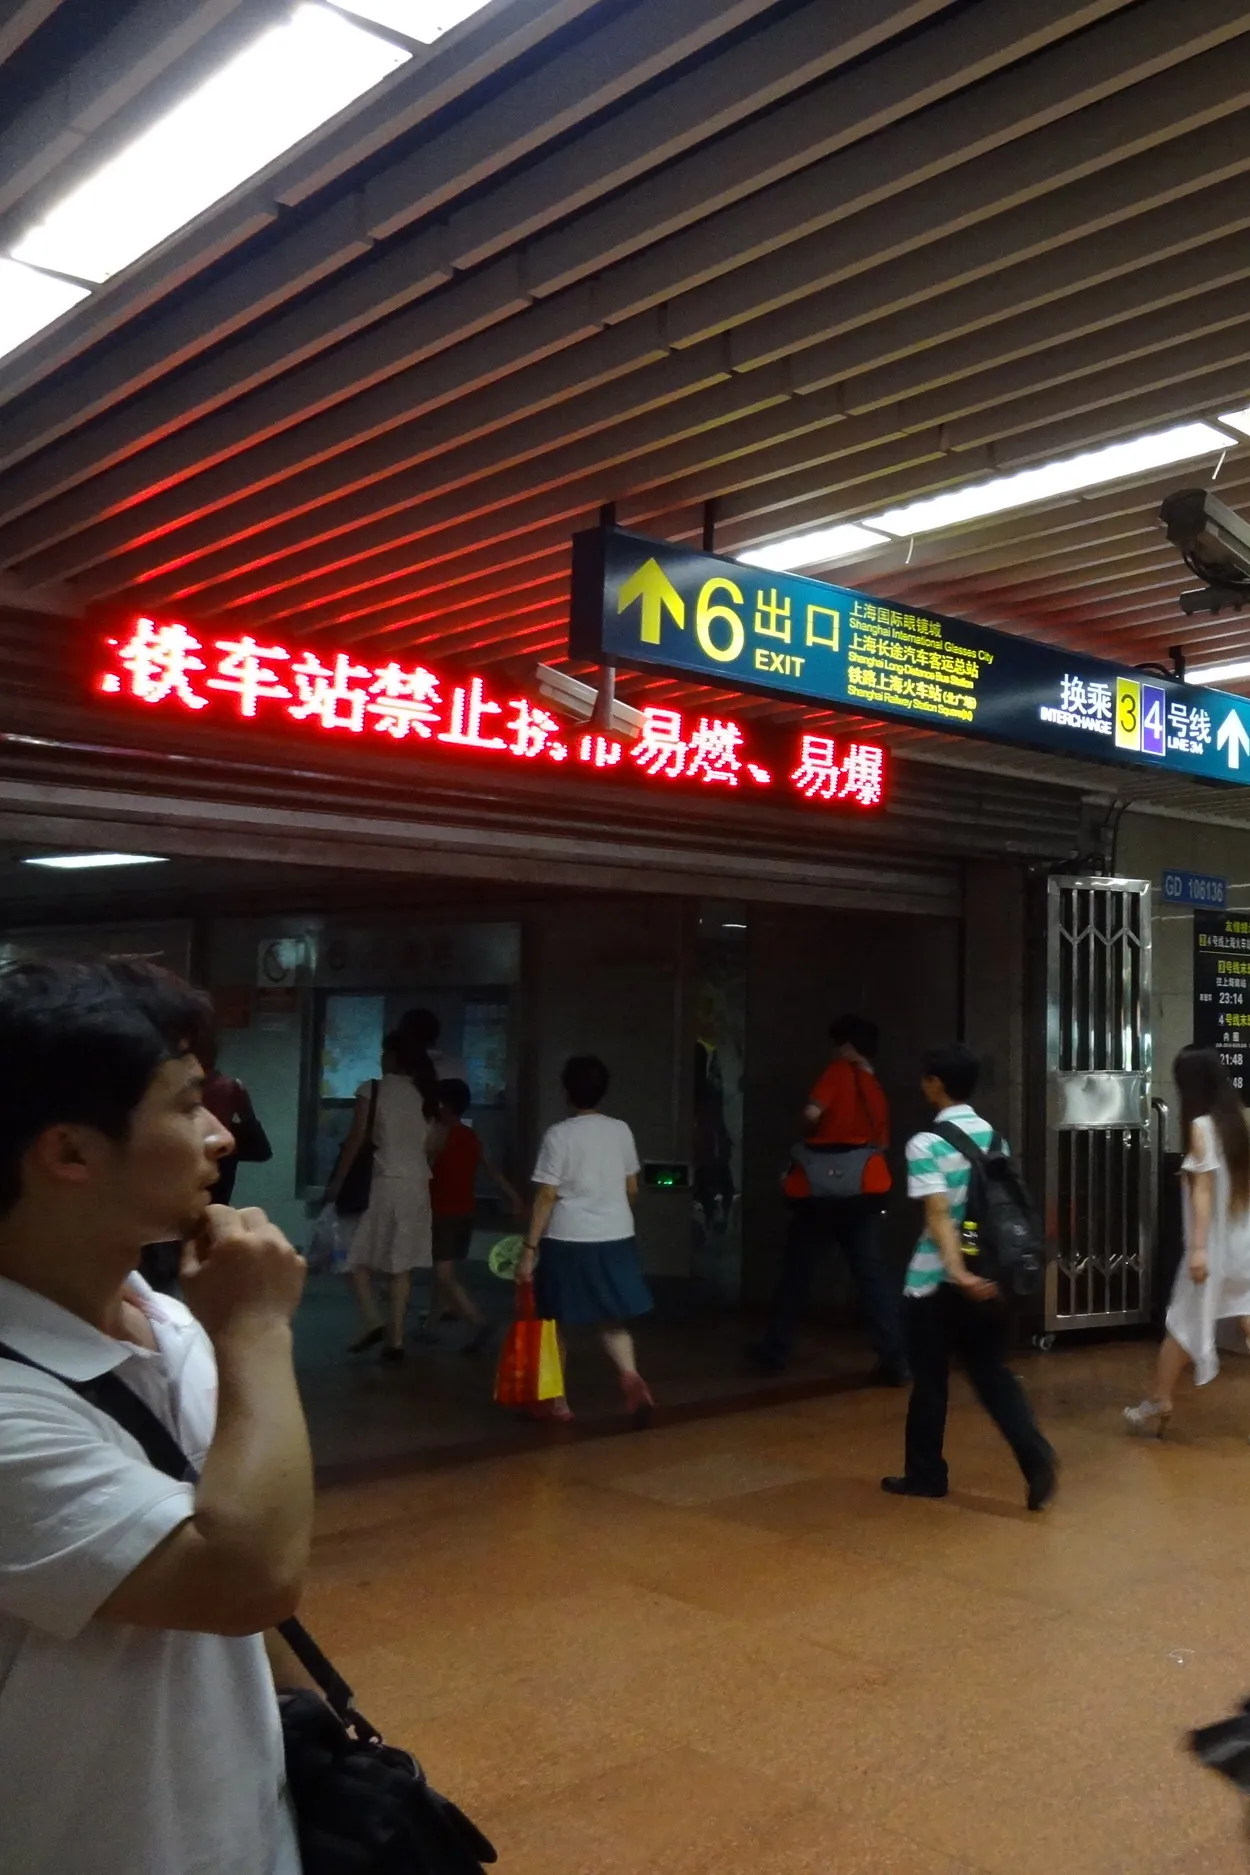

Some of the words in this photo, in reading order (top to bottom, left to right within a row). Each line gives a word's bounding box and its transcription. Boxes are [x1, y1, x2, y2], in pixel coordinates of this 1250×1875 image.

[695, 577, 745, 663] 6
[754, 588, 840, 652] 出口
[849, 600, 942, 638] 上海国际眼镜城
[849, 617, 891, 637] Shanghai
[892, 628, 943, 648] International
[944, 641, 977, 659] Glasses
[977, 646, 994, 664] City
[849, 633, 980, 679] 上海长途汽车客运总站
[755, 648, 805, 678] EXIT
[848, 651, 885, 670] Shanghai
[936, 673, 949, 684] Bus
[950, 675, 974, 689] Station
[848, 685, 883, 702] Shanghai
[884, 692, 913, 709] Railway
[913, 699, 937, 713] Station
[1060, 674, 1112, 719] 换乘
[1120, 693, 1136, 733] 3
[1143, 700, 1163, 739] 4
[1167, 703, 1212, 743] 号线
[1040, 706, 1112, 736] INTERCHANGE
[1167, 735, 1189, 752] LINE
[1165, 875, 1183, 896] GD
[1219, 991, 1244, 1005] 23:14
